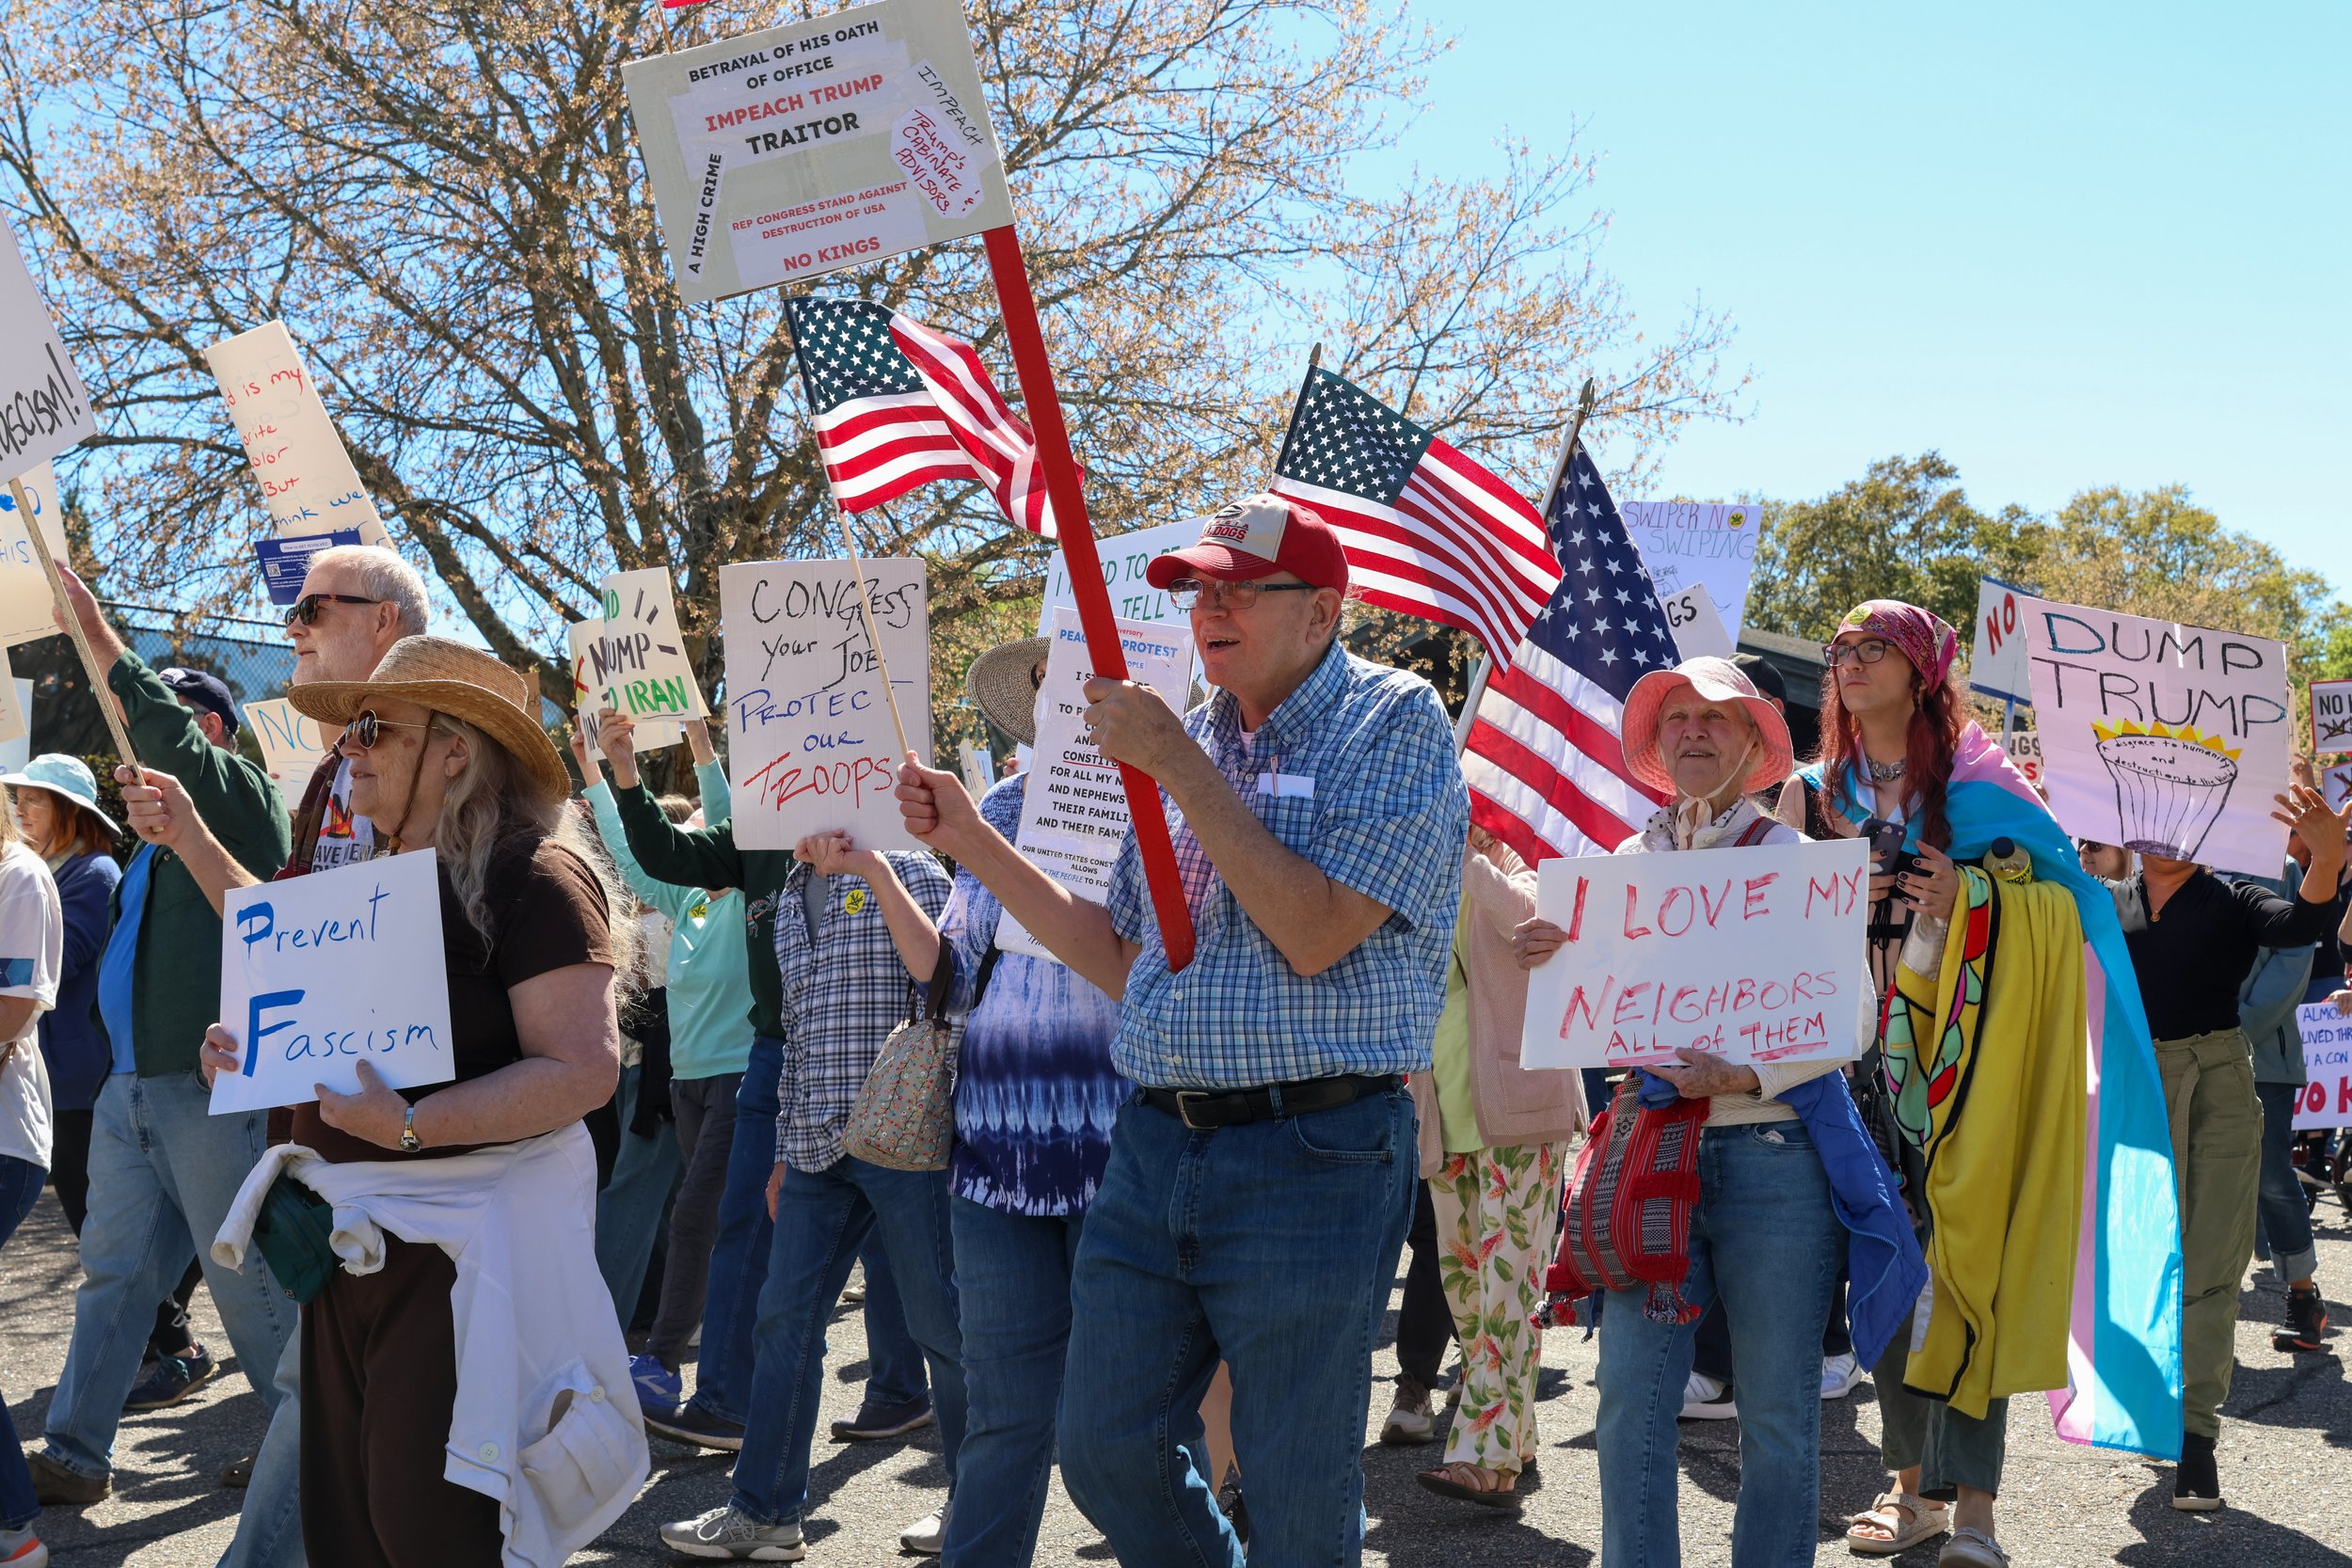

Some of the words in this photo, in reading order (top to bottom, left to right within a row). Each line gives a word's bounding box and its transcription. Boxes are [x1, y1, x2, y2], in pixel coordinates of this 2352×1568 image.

[689, 52, 770, 83] BETRAYAL
[772, 43, 794, 59] OF
[800, 34, 831, 52] HIS
[834, 20, 880, 42] OATH
[746, 73, 768, 89] OF
[772, 56, 834, 82] OFFICE
[705, 94, 804, 132] IMPEACH
[809, 74, 883, 104] TRUMP
[918, 65, 984, 146] IMPEACH
[745, 112, 860, 154] TRAITOR
[902, 126, 961, 192] CABINATE
[701, 152, 722, 208] CRIME
[732, 219, 753, 231] REP
[756, 204, 816, 225] CONGRESS
[818, 195, 855, 212] STAND
[858, 182, 908, 201] AGAINST
[762, 213, 842, 240] DESTRUCTION
[845, 209, 860, 219] OF
[863, 203, 886, 215] USA
[691, 213, 710, 258] HIGH
[688, 262, 701, 274] A
[783, 252, 812, 272] NO
[818, 236, 881, 263] KINGS
[243, 382, 261, 397] is
[271, 368, 303, 396] my
[0, 342, 81, 461] ASCISM!
[263, 478, 299, 497] But
[1625, 501, 1700, 530] SWIPER
[1708, 504, 1747, 531] NO
[0, 539, 29, 563] HIS
[1647, 530, 1755, 560] SWIPING
[1056, 572, 1062, 596] I
[1126, 553, 1149, 581] TO
[1122, 593, 1165, 622] TELL
[1986, 592, 2016, 657] NO
[1122, 640, 1178, 658] PROTEST
[2042, 612, 2264, 675] DUMP
[1076, 672, 1081, 681] I
[1125, 660, 1144, 670] OPLE
[625, 675, 689, 715] IRAN
[1059, 704, 1073, 714] TO
[2031, 656, 2287, 738] TRUMP
[2318, 694, 2344, 716] NO
[1074, 735, 1095, 746] AN
[2115, 737, 2155, 749] disgrace
[1050, 766, 1071, 778] FOR
[1073, 769, 1091, 781] ALL
[1095, 773, 1112, 784] MY
[2115, 756, 2181, 782] destruction
[2152, 756, 2175, 765] and
[743, 752, 893, 811] TROOPS
[1048, 784, 1070, 795] AND
[1073, 787, 1125, 804] NEPHEWS
[1036, 816, 1058, 828] AND
[1062, 820, 1095, 834] THEIR
[1053, 801, 1085, 816] THEIR
[1089, 808, 1131, 823] FAMILI
[1022, 845, 1035, 853] OUR
[1037, 848, 1063, 858] UNITED
[1064, 853, 1089, 863] STATES
[1089, 858, 1114, 868] CONST
[1071, 863, 1098, 875] ALLOWS
[1049, 869, 1059, 878] THE
[1060, 872, 1084, 883] PEOPLE
[1568, 876, 1589, 942] I
[1624, 872, 1780, 940] LOVE
[1804, 865, 1863, 919] MY
[236, 881, 390, 960] Prevent
[1559, 971, 1836, 1039] NEIGHBORS
[242, 989, 439, 1078] Fascism
[1604, 1030, 1674, 1056] ALL
[1740, 1011, 1826, 1051] THEM
[2301, 1029, 2333, 1044] LIVED
[2314, 1053, 2322, 1066] A
[2326, 1051, 2348, 1065] CON
